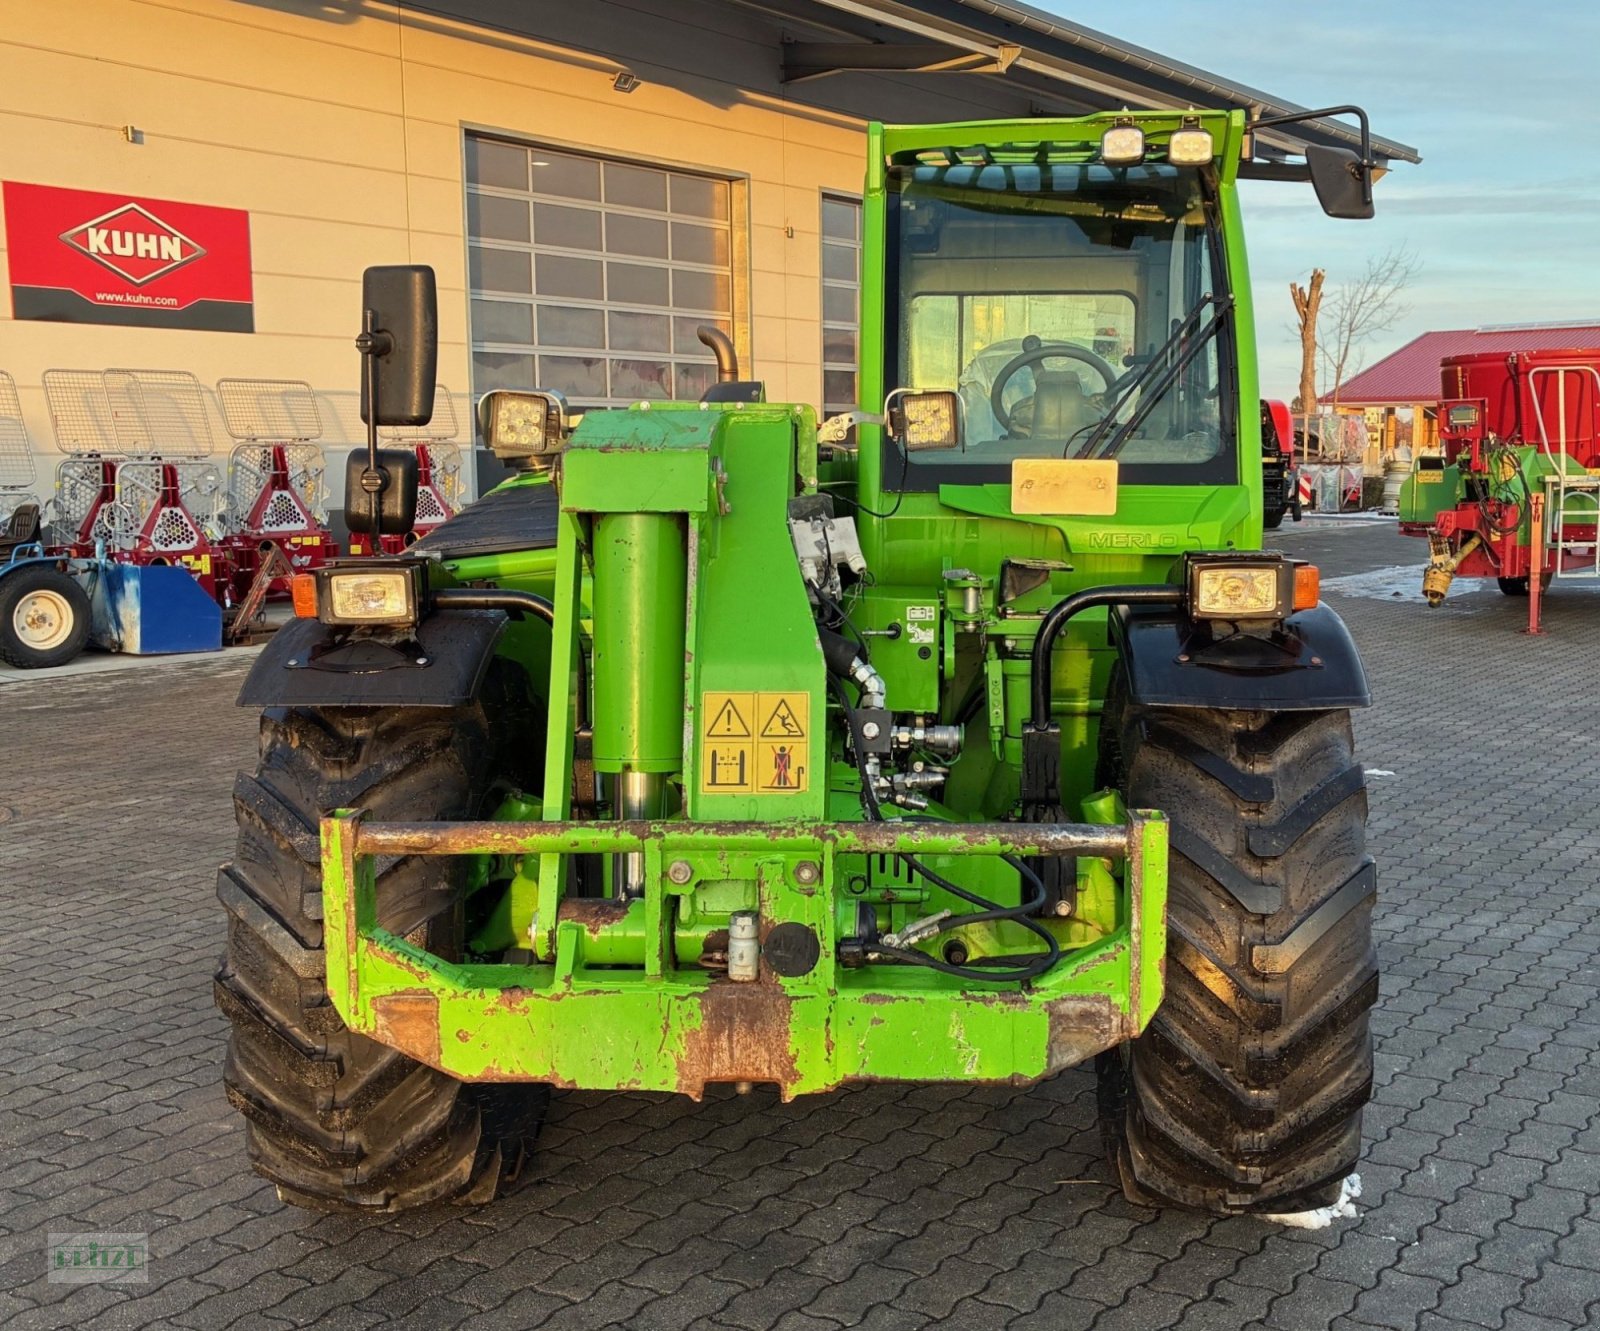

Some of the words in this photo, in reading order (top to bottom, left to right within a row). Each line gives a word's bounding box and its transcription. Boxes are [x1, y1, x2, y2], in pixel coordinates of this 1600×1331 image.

[87, 227, 182, 261] KUHN
[95, 292, 178, 306] www.kuhn.com
[1089, 532, 1178, 548] MERLO
